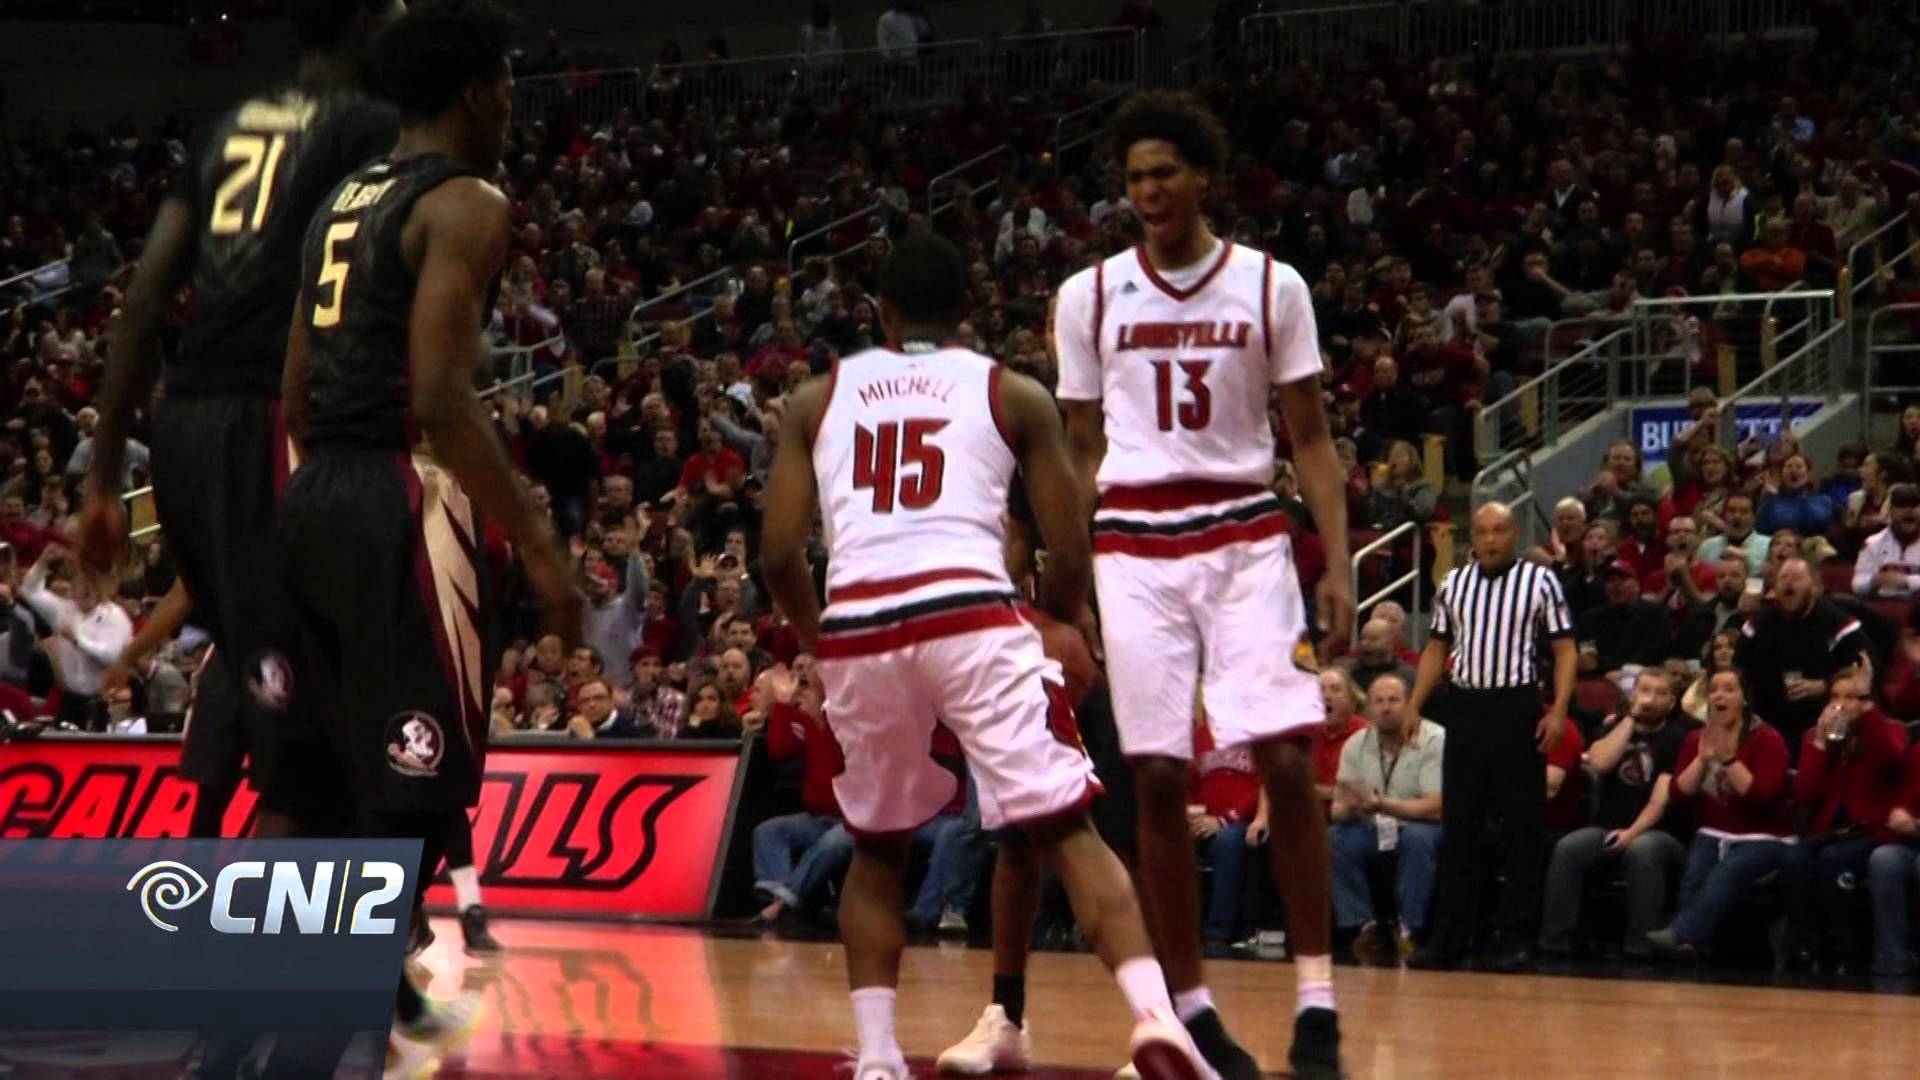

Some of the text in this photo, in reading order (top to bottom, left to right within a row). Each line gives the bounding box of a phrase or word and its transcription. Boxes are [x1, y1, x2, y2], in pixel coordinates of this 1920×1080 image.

[211, 134, 286, 233] 21
[312, 222, 360, 328] 5
[858, 376, 957, 408] MITCHELL
[1149, 360, 1212, 432] 13
[853, 418, 951, 513] 45
